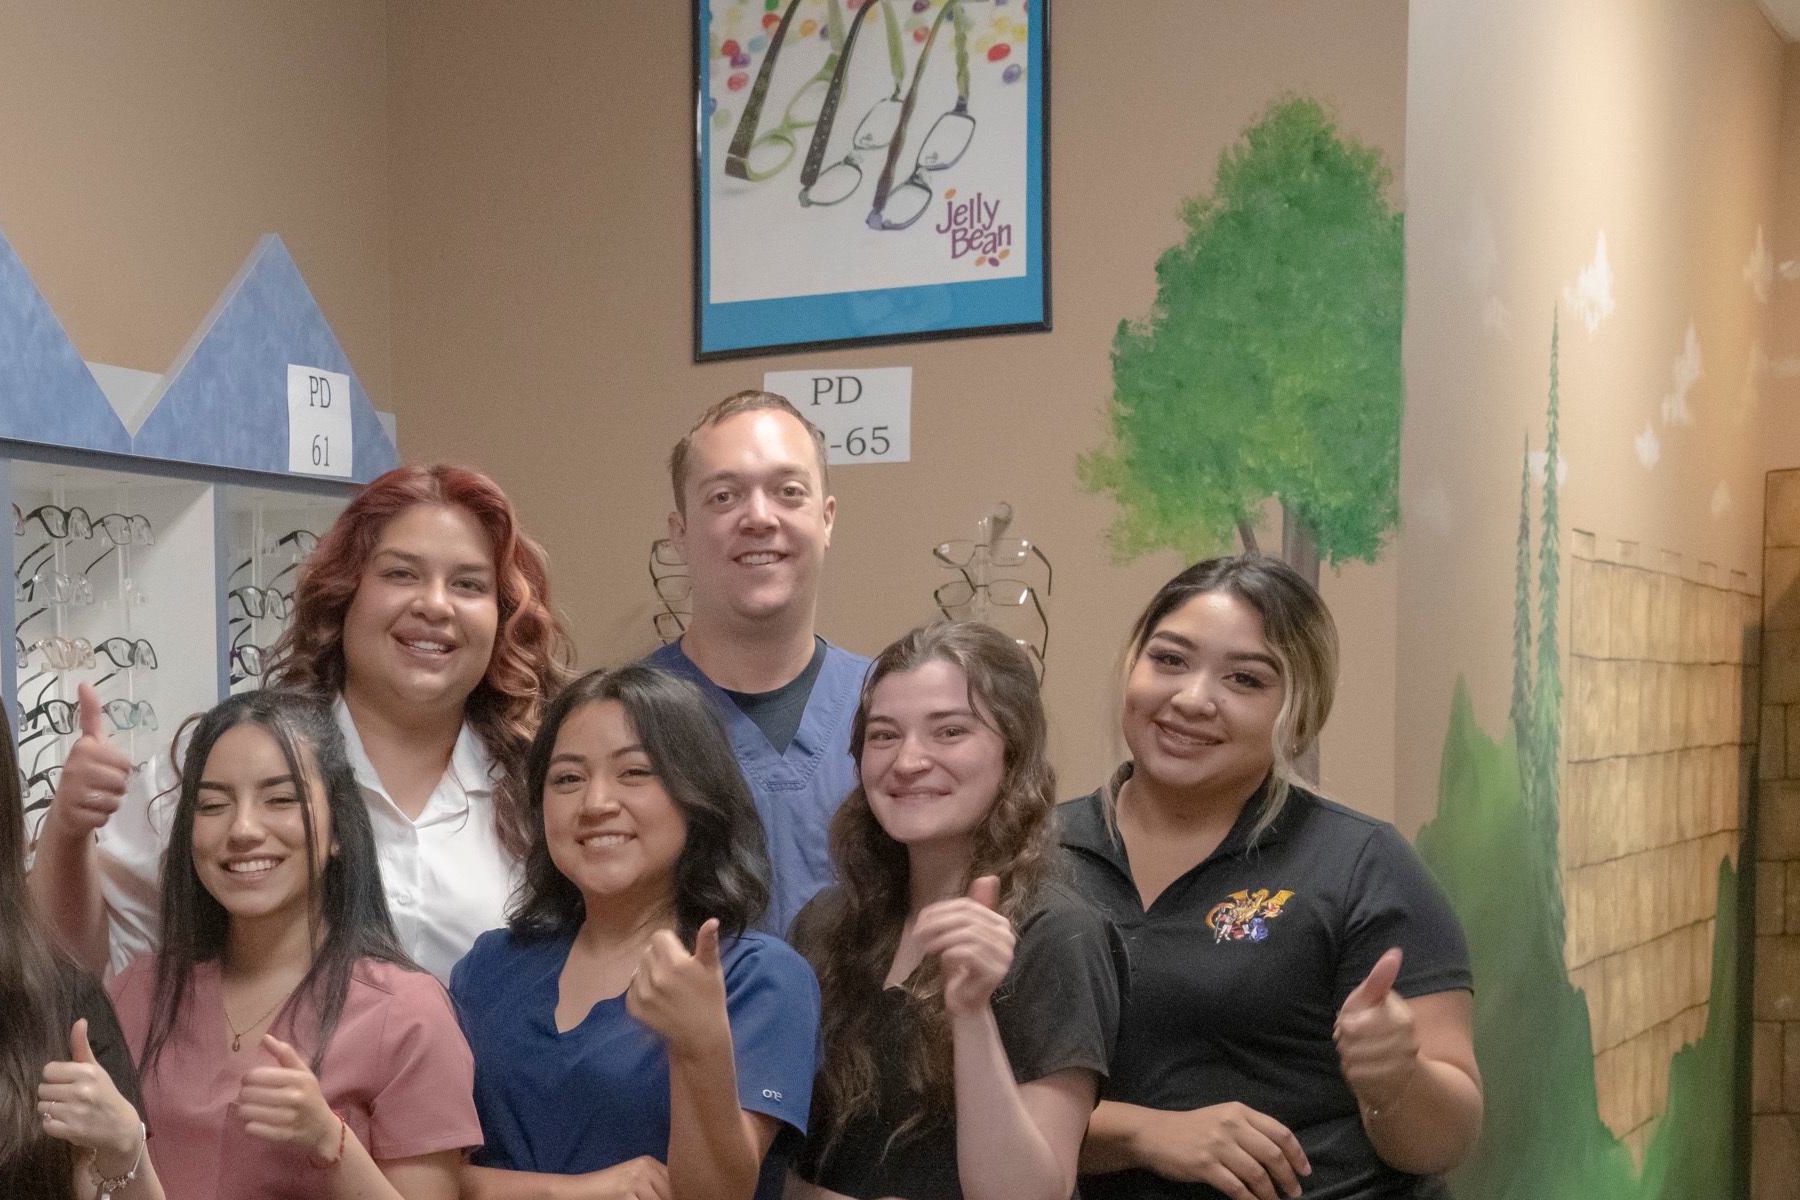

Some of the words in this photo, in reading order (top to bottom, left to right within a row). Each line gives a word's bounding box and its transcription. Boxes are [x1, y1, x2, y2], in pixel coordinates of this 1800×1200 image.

[952, 224, 1011, 259] Bean
[309, 375, 331, 408] PD
[810, 376, 863, 406] PD
[312, 433, 330, 467] 61
[818, 425, 890, 457] -65
